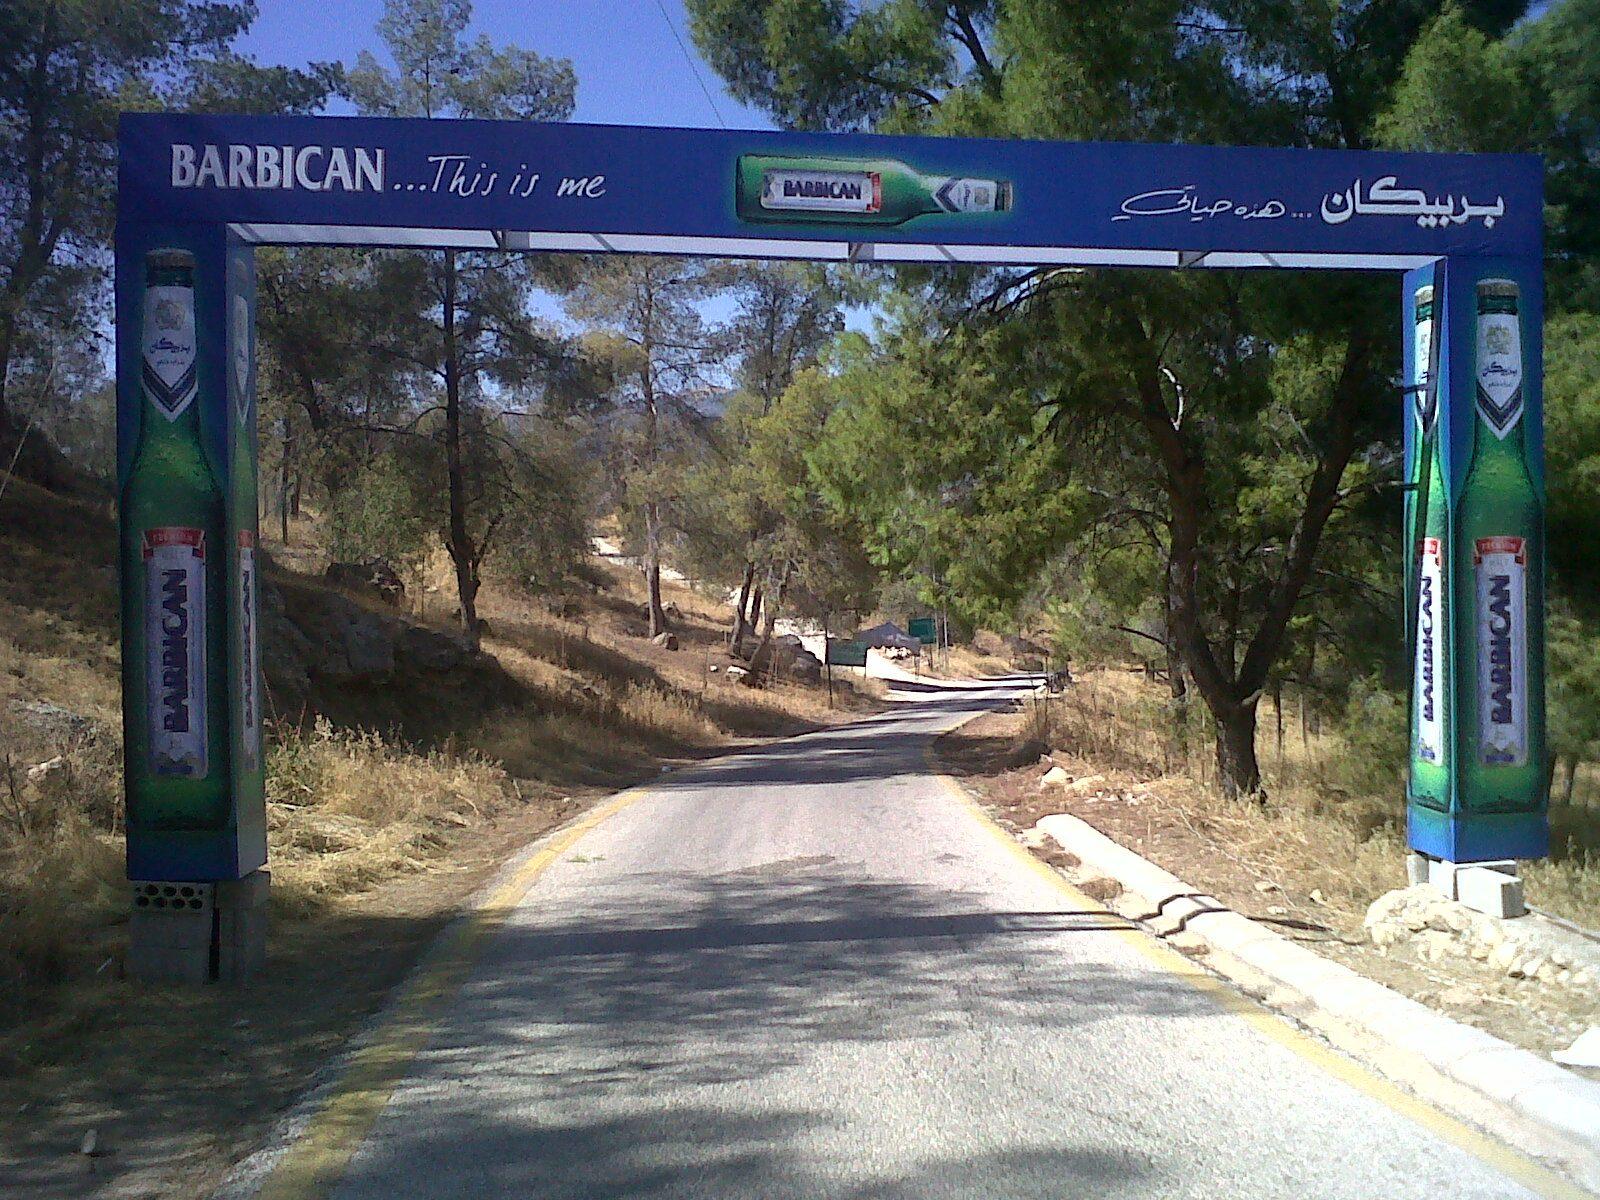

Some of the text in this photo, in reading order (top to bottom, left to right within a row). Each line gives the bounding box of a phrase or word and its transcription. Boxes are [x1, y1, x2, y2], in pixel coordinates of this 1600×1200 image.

[171, 144, 384, 192] BARBICAN
[508, 164, 539, 198] is
[557, 173, 608, 199] me
[783, 180, 862, 200] BARBICAN
[1320, 175, 1505, 229] بربيكان
[162, 569, 188, 732] BARBICAN
[1489, 574, 1513, 724] BARBICAN
